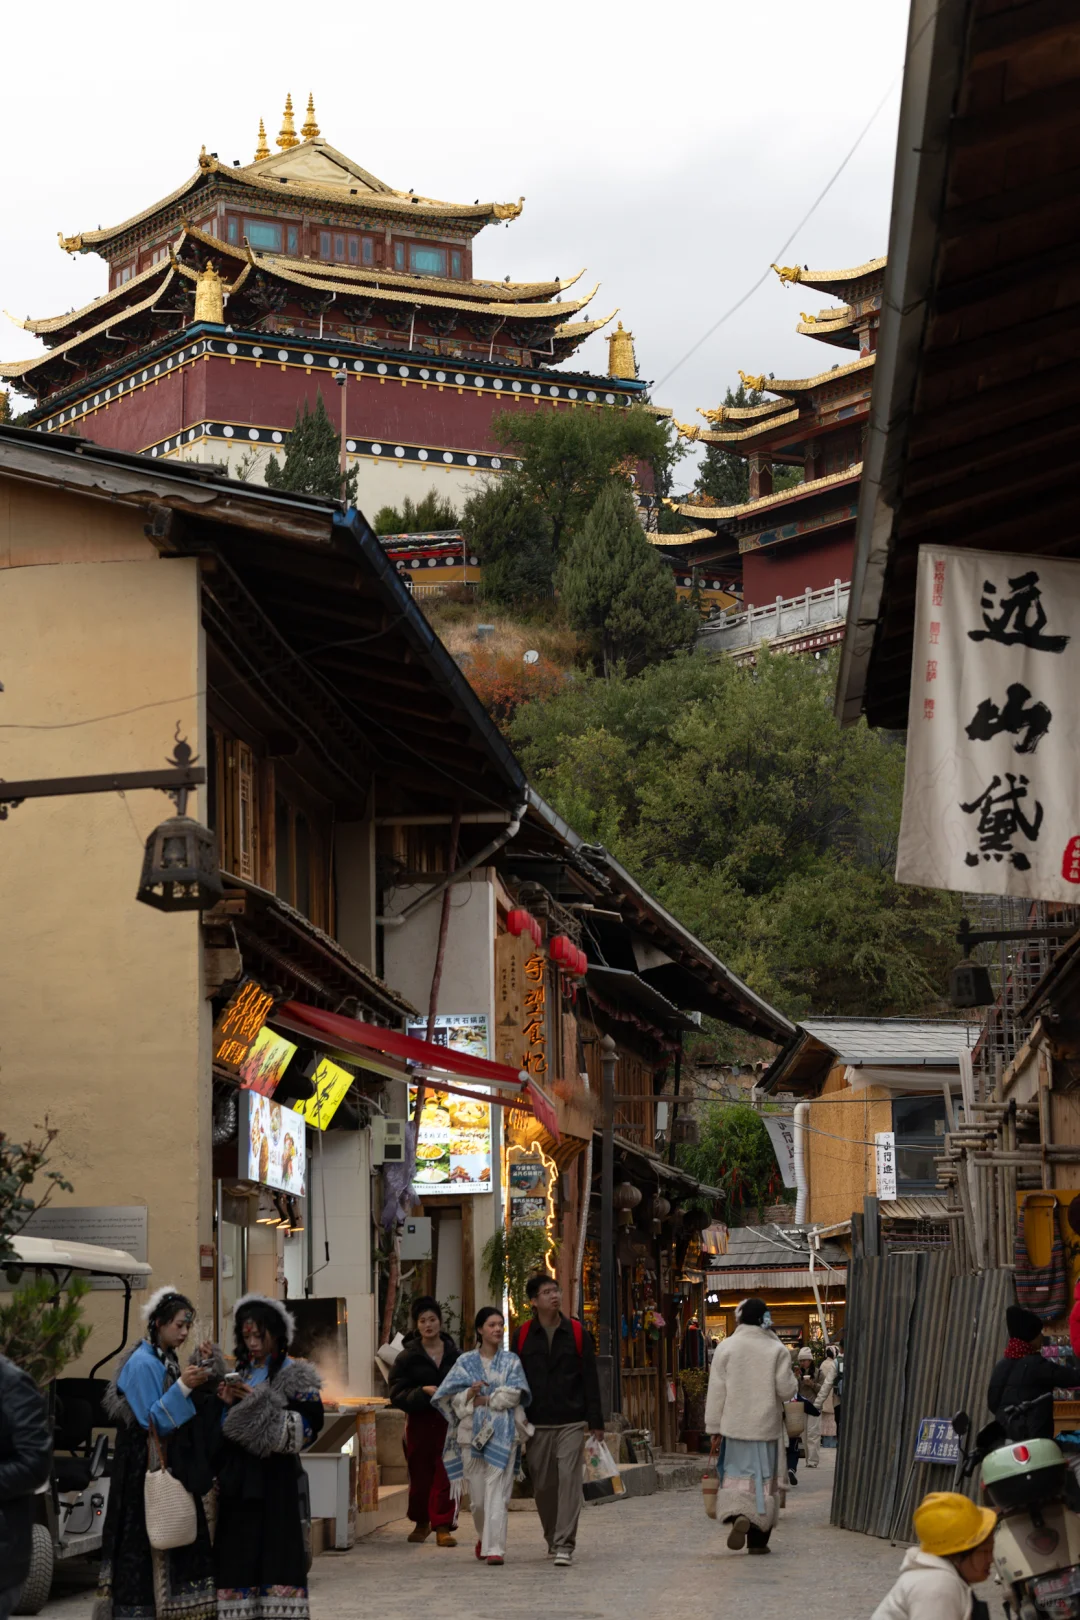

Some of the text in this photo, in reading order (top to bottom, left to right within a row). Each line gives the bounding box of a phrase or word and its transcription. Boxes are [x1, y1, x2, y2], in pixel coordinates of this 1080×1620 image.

[931, 560, 945, 607] 香格里拉
[959, 571, 1071, 872] 远山黛
[520, 953, 549, 1075] 守望食忆
